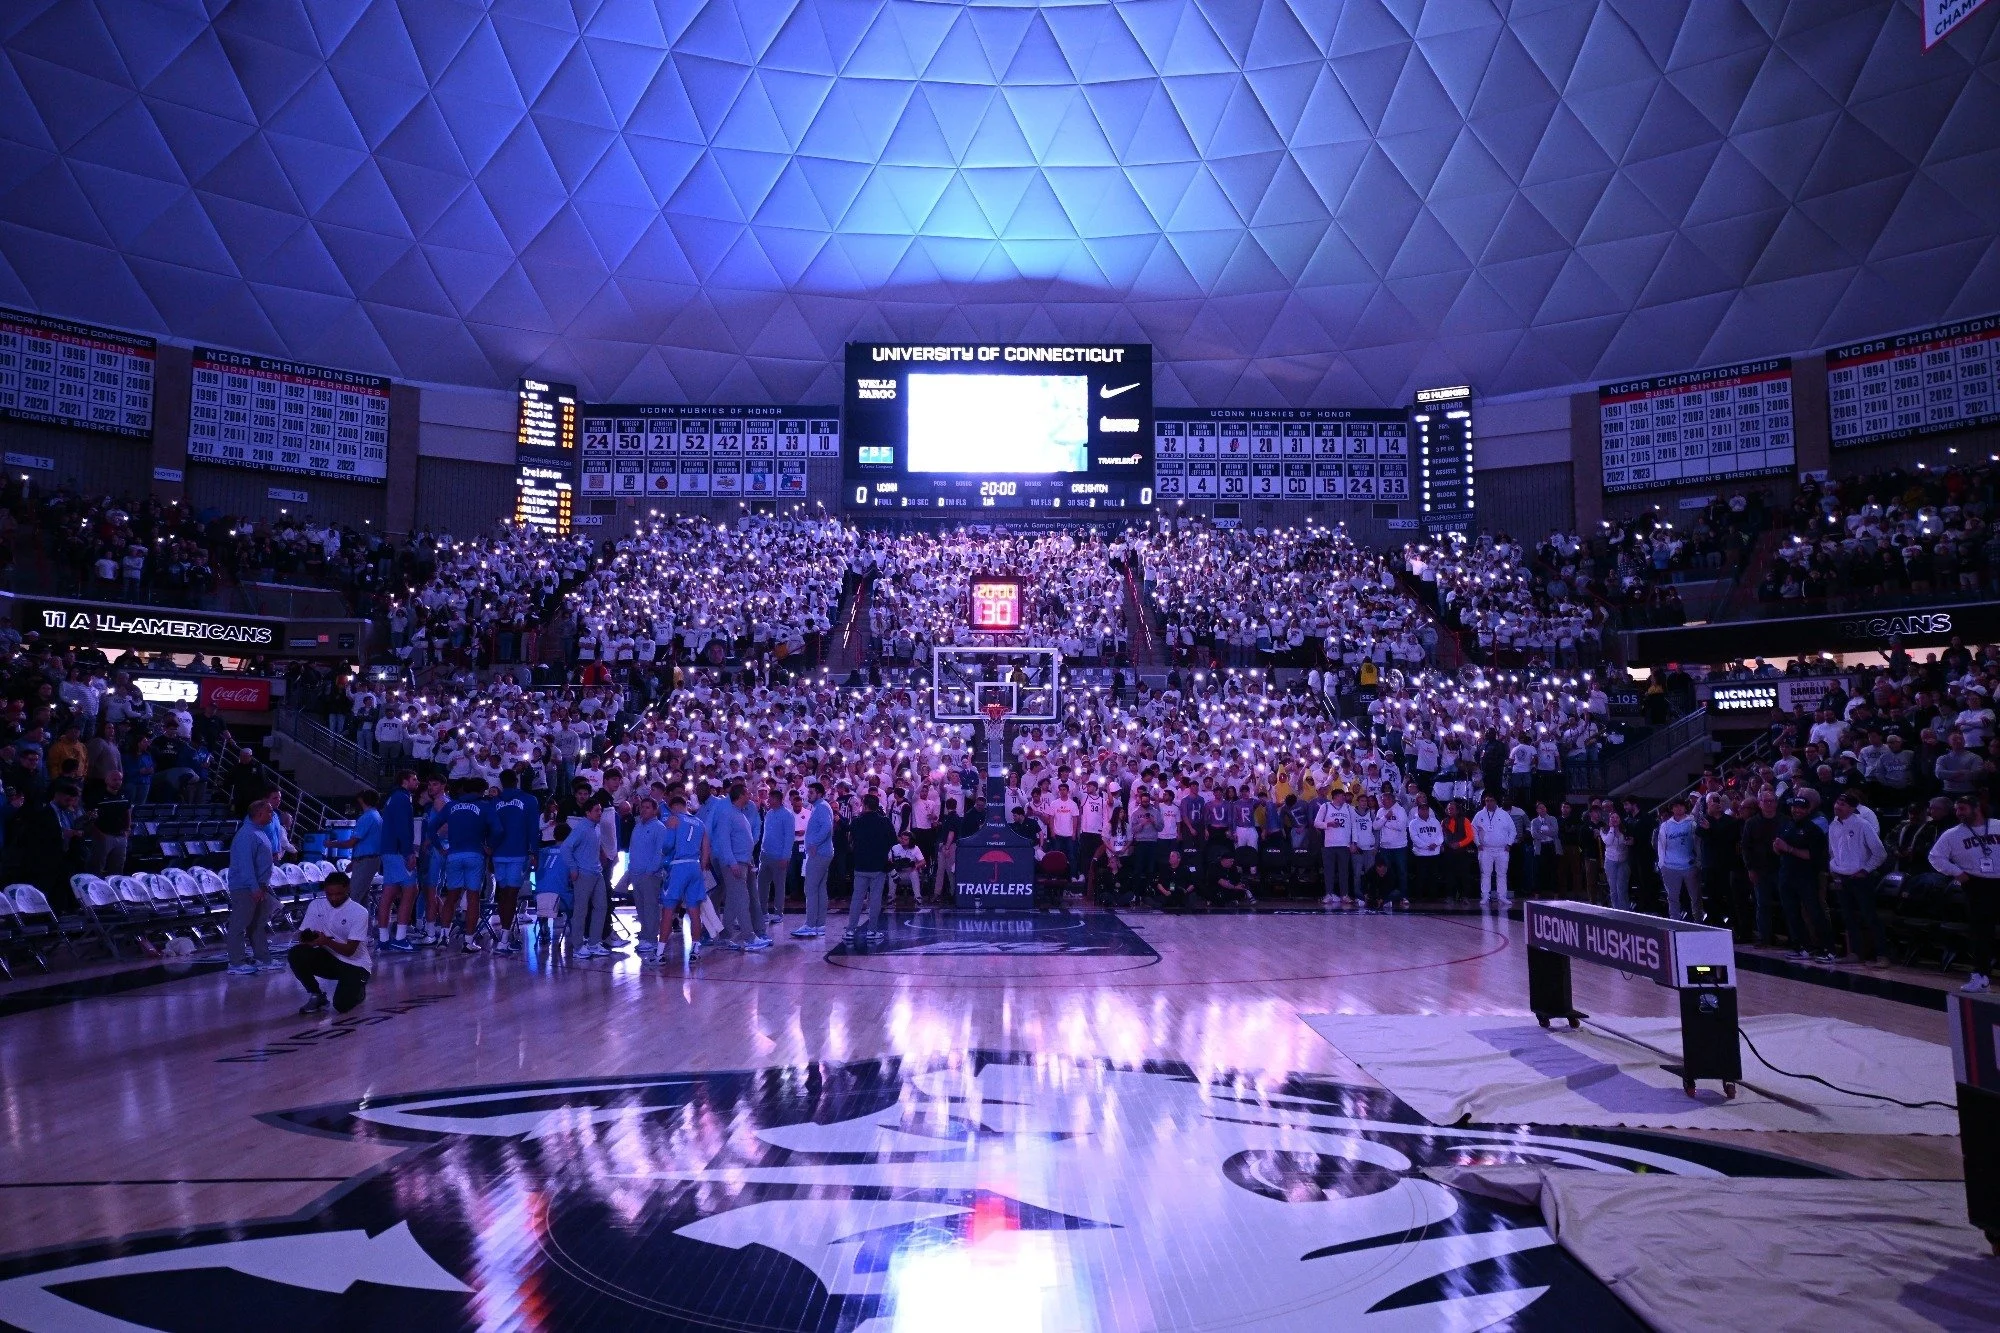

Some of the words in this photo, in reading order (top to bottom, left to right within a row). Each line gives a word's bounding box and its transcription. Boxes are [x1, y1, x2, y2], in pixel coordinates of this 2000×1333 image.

[41, 320, 88, 335] ATHLETIC
[91, 330, 152, 347] CONFERENCE
[52, 333, 135, 354] CHAMPIONS
[1839, 342, 1885, 359] NCAA
[1895, 344, 1932, 356] ELITE
[1941, 334, 1981, 345] EIGHT
[872, 346, 974, 362] UNIVERSITY
[977, 347, 1000, 362] OF
[1004, 347, 1125, 363] CONNECTICUT
[207, 352, 250, 365] NCAA
[261, 361, 379, 384] CHAMPIONSHIP
[1833, 370, 1853, 383] 1991
[1863, 364, 1885, 378] 1994
[1895, 358, 1916, 372] 1995
[1927, 351, 1950, 365] 1996
[1961, 344, 1983, 359] 1997
[206, 362, 288, 381] TOURNAMENT
[296, 377, 380, 395] APPEARANCES
[525, 380, 548, 391] UConn
[858, 379, 896, 388] WELLS
[1610, 382, 1650, 394] NCAA
[1658, 361, 1779, 387] CHAMPIONSHIP
[1834, 388, 1855, 401] 2001
[1863, 382, 1886, 396] 2002
[1895, 375, 1919, 390] 2003
[1927, 370, 1952, 384] 2004
[859, 389, 896, 399] FARGO
[1431, 388, 1469, 399] HUSKIES
[1645, 387, 1684, 398] SWEET
[1691, 379, 1741, 391] SIXTEEN
[1834, 405, 1857, 418] 2009
[1897, 394, 1920, 408] 2011
[1930, 388, 1952, 401] 2012
[1964, 381, 1987, 396] 2013
[680, 407, 725, 415] HUSKIES
[1835, 423, 1857, 436] 2016
[1866, 418, 1888, 431] 2017
[1931, 406, 1954, 420] 2019
[1966, 401, 1988, 414] 2021
[10, 410, 68, 425] WOMEN'S
[74, 418, 149, 438] BASKETBALL
[1740, 437, 1760, 449] 2019
[1771, 433, 1789, 445] 2021
[1834, 429, 1912, 447] CONNECTICUT
[1920, 419, 1976, 433] WOMEN'S
[587, 435, 608, 449] 24
[620, 435, 640, 449] 50
[654, 435, 671, 449] 21
[686, 435, 704, 449] 52
[717, 436, 738, 449] 42
[752, 436, 767, 449] 25
[786, 436, 798, 449] 33
[820, 436, 829, 450] 10
[1164, 438, 1176, 452] 32
[1199, 438, 1204, 452] 3
[1292, 439, 1302, 452] 31
[1322, 439, 1335, 452] 23
[1354, 439, 1366, 453] 31
[1386, 439, 1399, 453] 14
[35, 459, 48, 467] 13
[193, 455, 264, 469] CONNECTICUT
[271, 465, 315, 475] WOMEN'S
[321, 471, 381, 483] BASKETBALL
[523, 467, 562, 479] Creighton
[1607, 471, 1625, 482] 2022
[1633, 468, 1650, 479] 2023
[1607, 481, 1671, 492] CONNECTICUT
[1677, 473, 1720, 485] WOMEN'S
[1726, 467, 1790, 479] BASKETBALL
[980, 482, 1017, 495] 20:00
[1072, 484, 1108, 493] CREIGHTON
[1161, 478, 1179, 492] 23
[1198, 478, 1206, 492] 4
[1226, 478, 1243, 492] 30
[1262, 478, 1270, 492] 3
[1289, 478, 1306, 492] CD
[1323, 479, 1335, 492] 15
[1351, 479, 1372, 492] 24
[1384, 479, 1404, 492] 33
[857, 487, 867, 503] 0
[1141, 488, 1152, 504] 0
[1402, 520, 1419, 528] 205
[978, 584, 1014, 599] 20:00
[43, 611, 66, 628] 11
[982, 600, 1011, 625] 30
[1617, 695, 1637, 704] 105
[1715, 689, 1776, 699] MICHAELS
[1718, 699, 1773, 709] JEWELERS
[451, 803, 480, 816] CREIGHTON
[1213, 807, 1224, 820] U
[1242, 808, 1250, 822] R
[957, 884, 1032, 895] TRAVELERS
[1534, 914, 1579, 948] UCONN
[1586, 924, 1659, 969] HUSKIES
